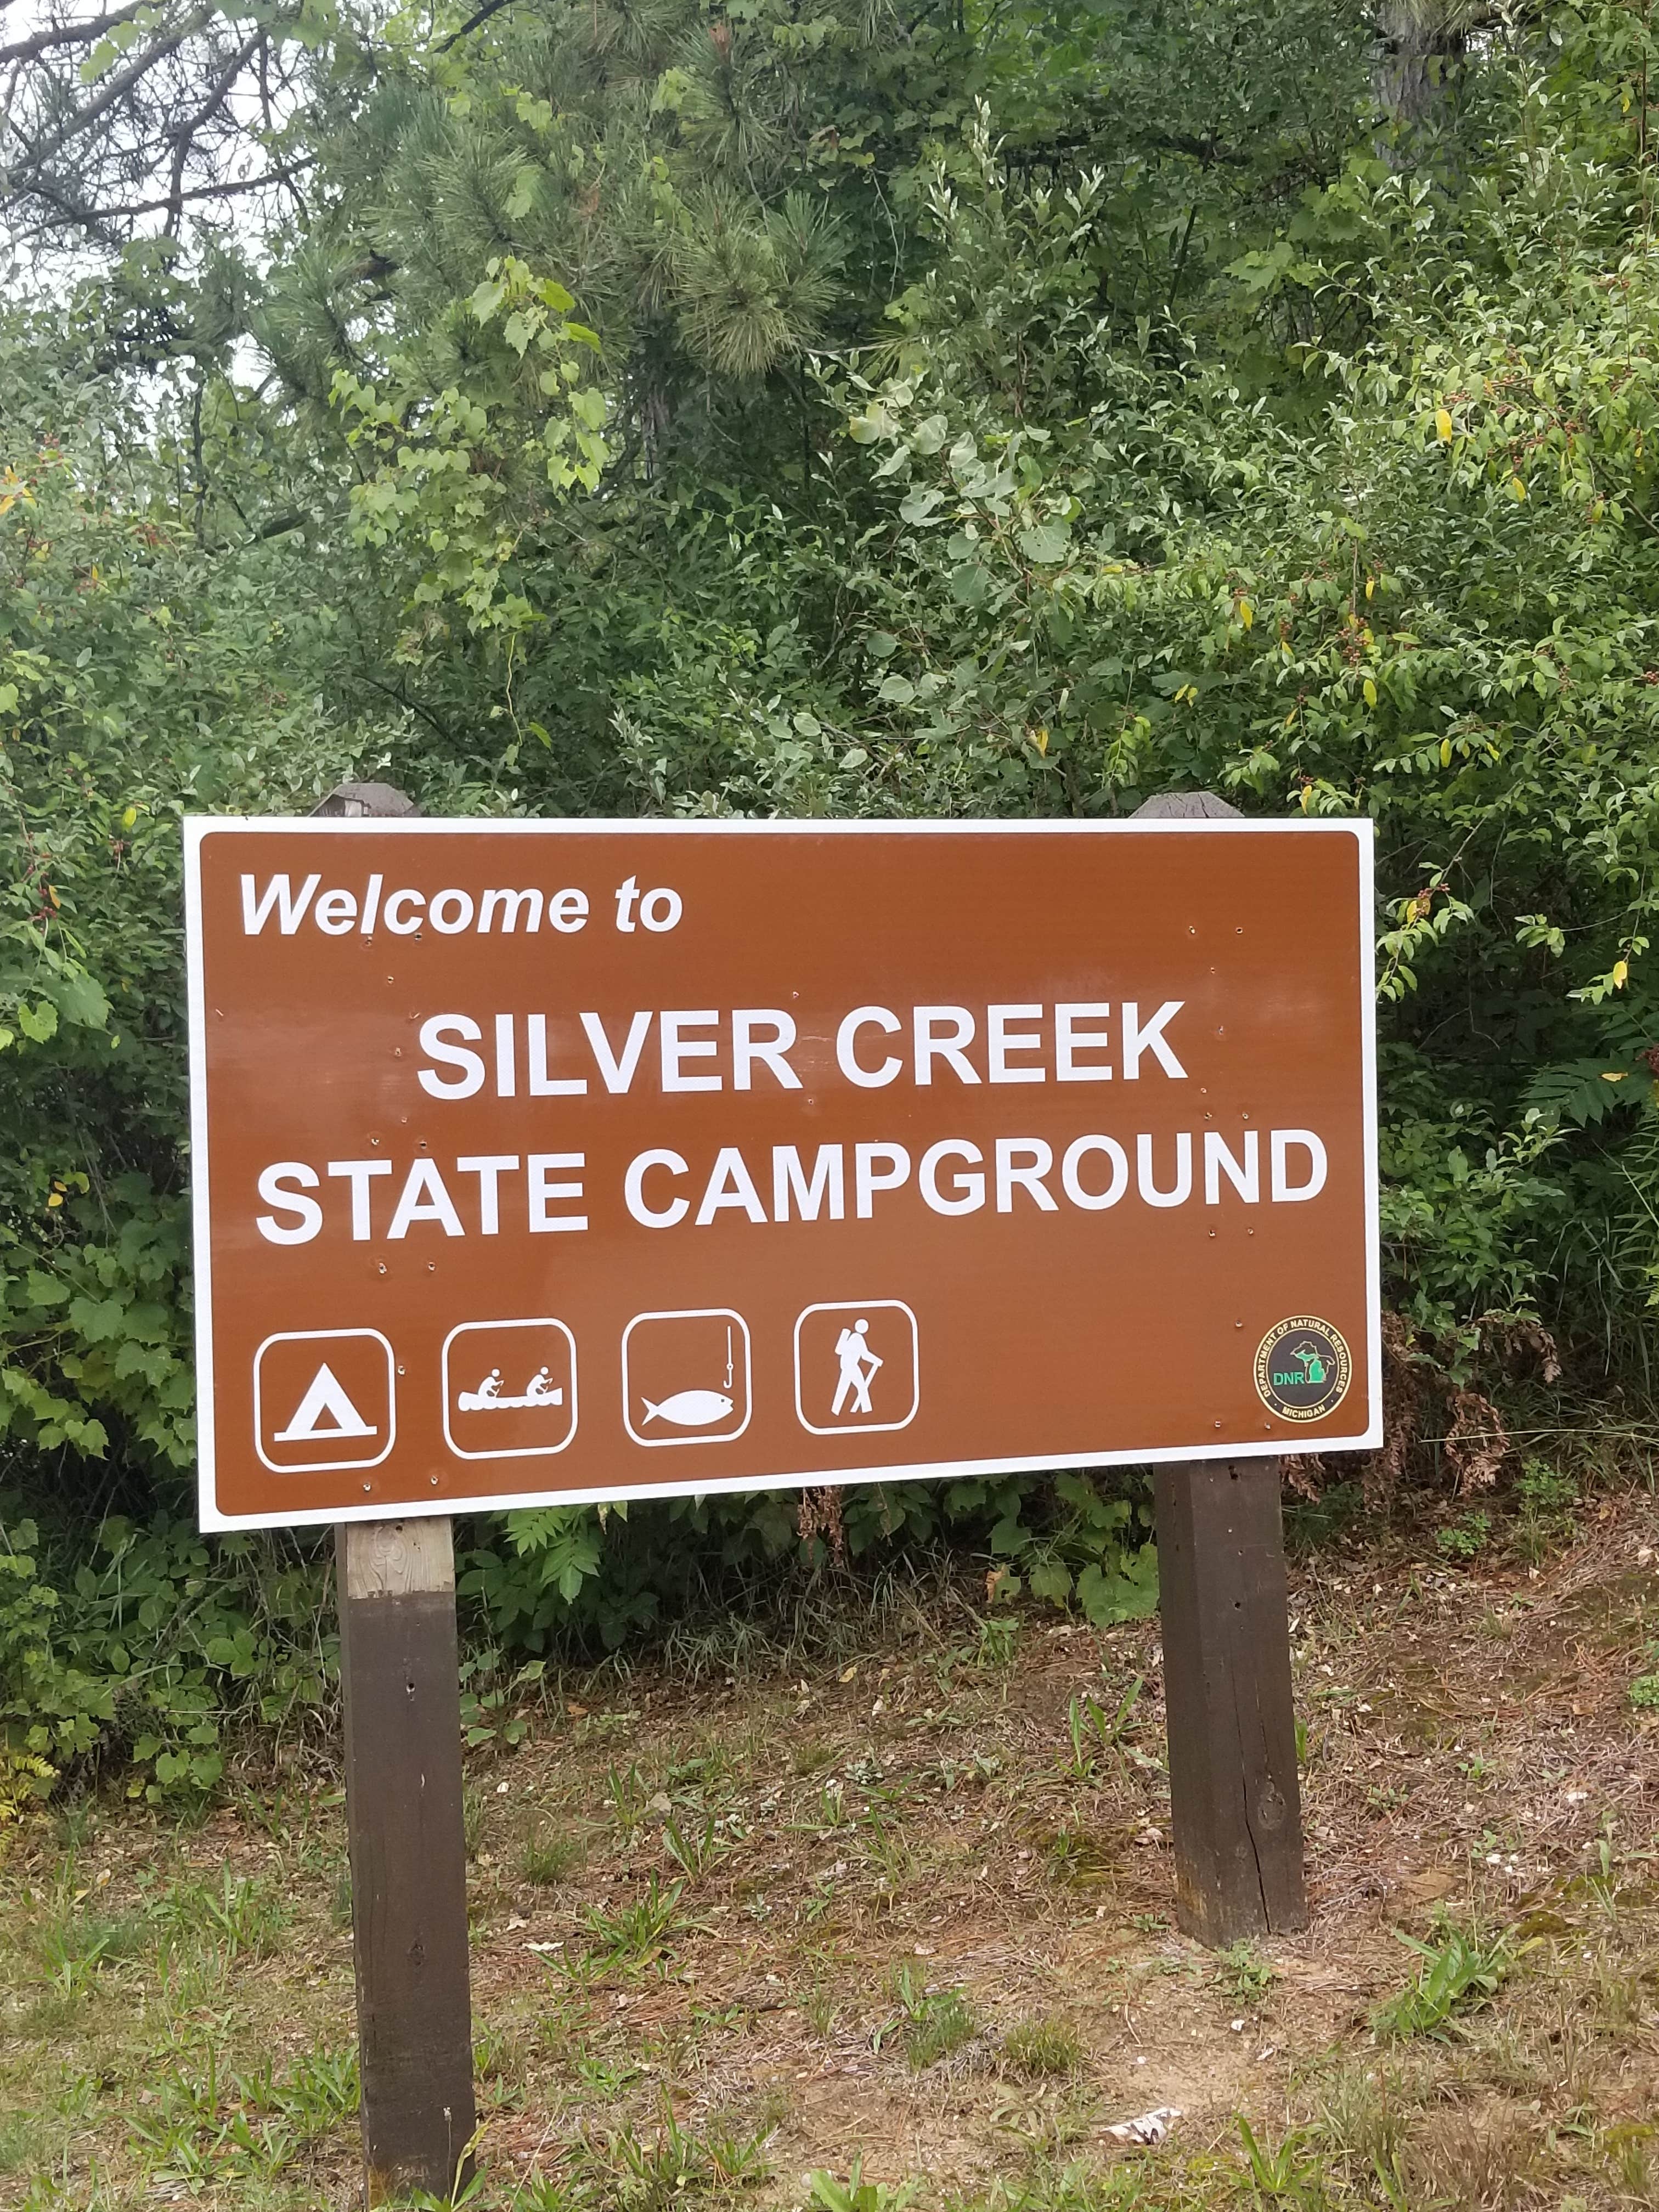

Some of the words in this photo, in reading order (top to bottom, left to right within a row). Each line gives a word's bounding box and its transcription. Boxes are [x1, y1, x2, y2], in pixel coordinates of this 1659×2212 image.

[240, 873, 589, 935] Welcome
[614, 875, 682, 933] to
[416, 1009, 804, 1100] SILVER
[836, 1001, 1188, 1088] CREEK
[255, 1152, 589, 1245] STATE
[624, 1129, 1328, 1228] CAMPGROUND
[1258, 1334, 1278, 1397] DEPARTMENT
[1277, 1324, 1289, 1335] OF
[1290, 1319, 1330, 1336] NATURAL
[1330, 1334, 1348, 1393] RESOURCES
[1273, 1372, 1305, 1385] DNR
[1282, 1404, 1325, 1418] MICHIGAN
